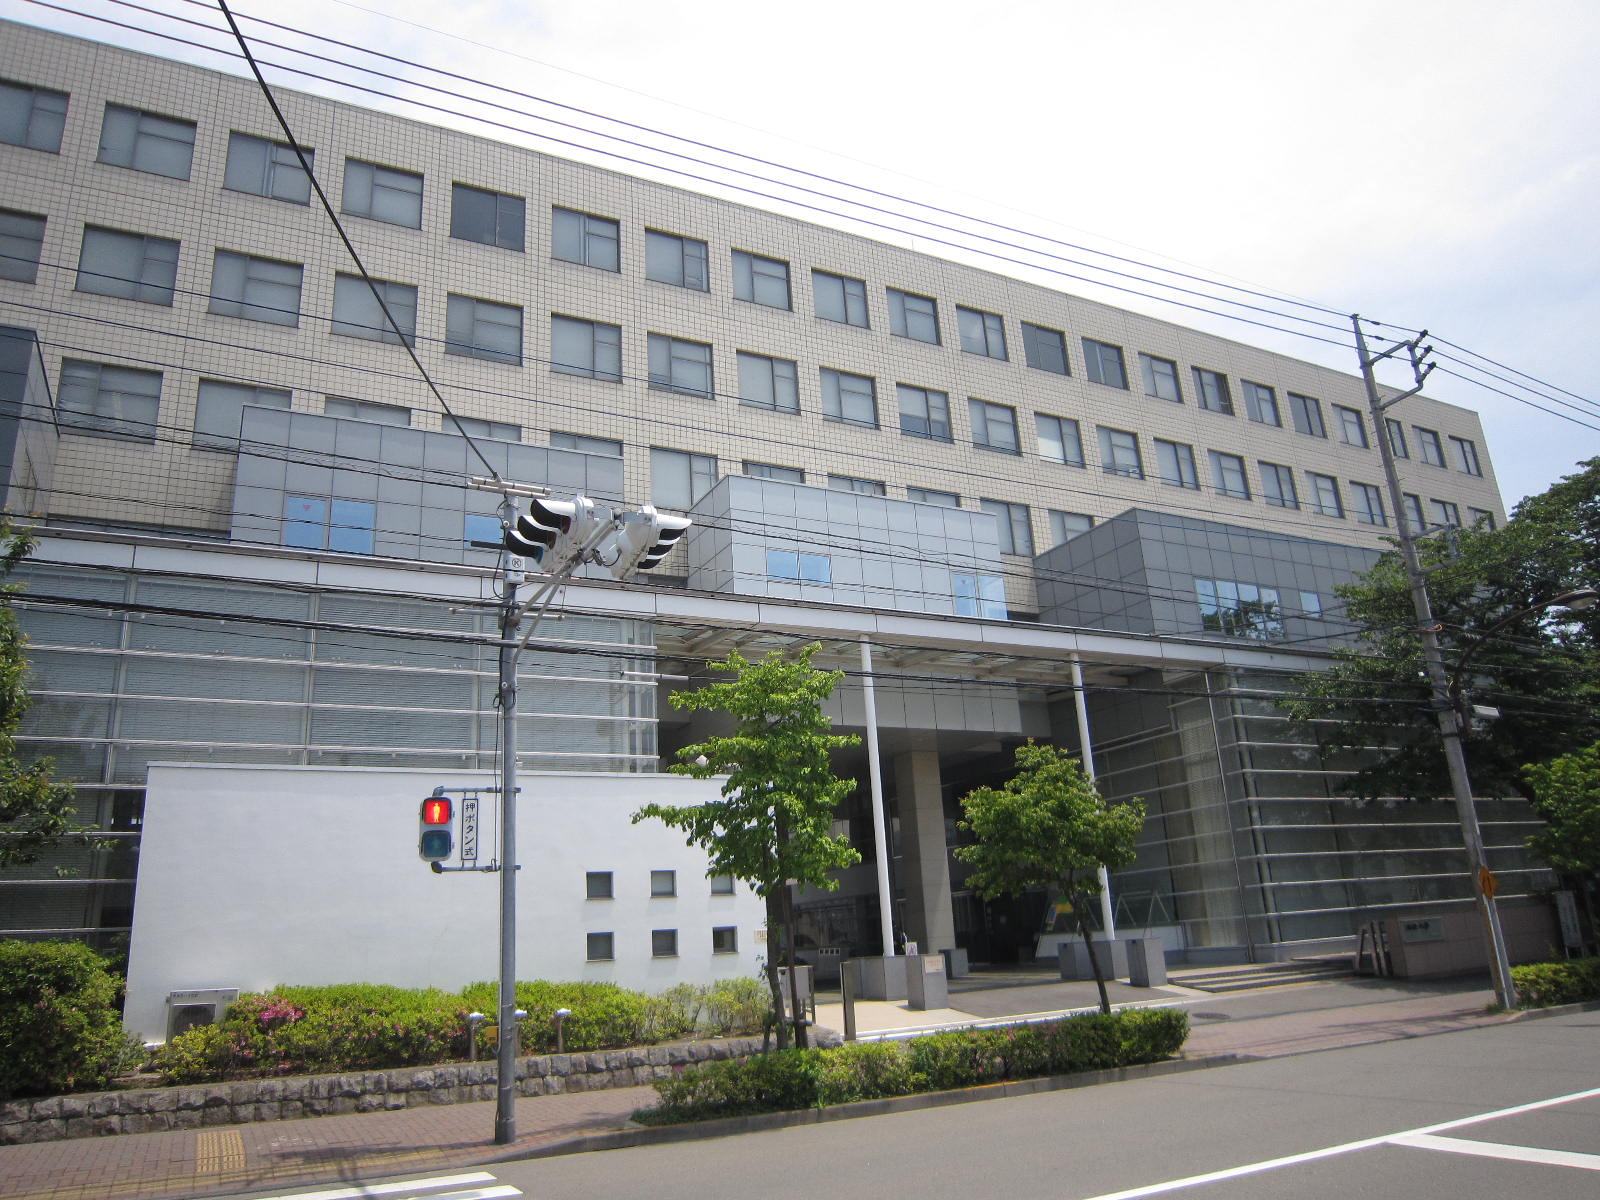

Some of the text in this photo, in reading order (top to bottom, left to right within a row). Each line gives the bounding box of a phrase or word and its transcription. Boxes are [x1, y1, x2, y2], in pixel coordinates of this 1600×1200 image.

[464, 802, 476, 856] 押ボタン式
